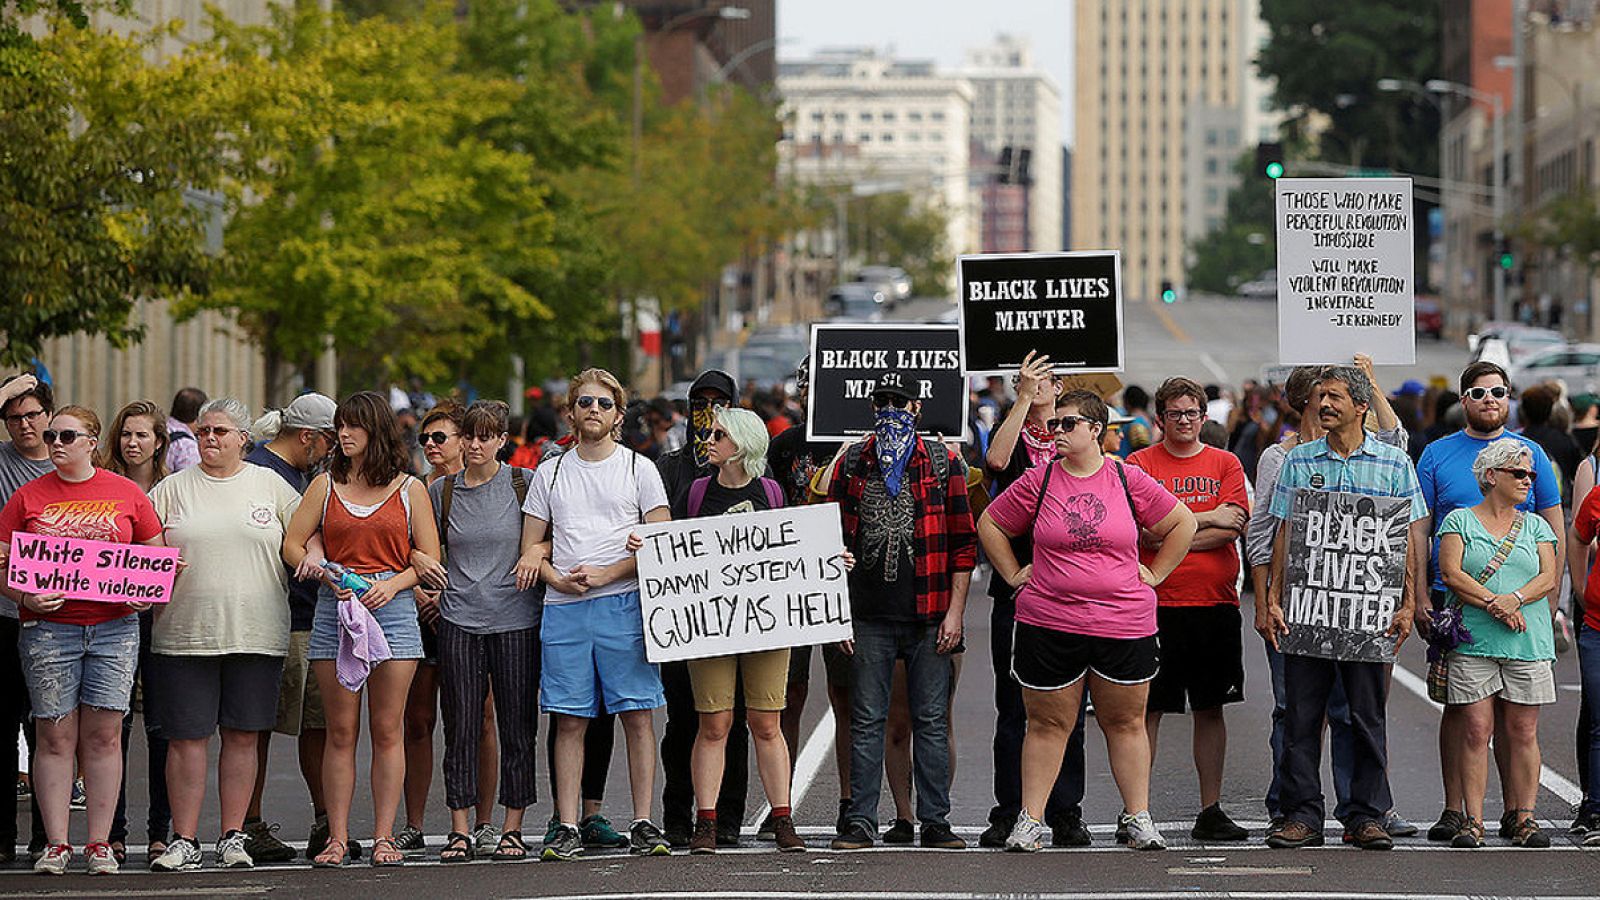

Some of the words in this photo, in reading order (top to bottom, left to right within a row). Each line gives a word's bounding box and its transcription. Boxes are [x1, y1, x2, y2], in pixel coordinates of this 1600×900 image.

[1282, 192, 1329, 209] THOSE
[1334, 192, 1364, 210] WHO
[1368, 193, 1403, 210] MAKE
[1286, 214, 1343, 230] PEACEFUL
[1346, 214, 1407, 231] REVOLUTION
[1313, 233, 1375, 248] IMPOSSIBLE
[1312, 260, 1340, 273] WILL
[1347, 260, 1378, 274] MAKE
[969, 279, 1037, 301] BLACK
[1045, 278, 1110, 299] LIVES
[1289, 275, 1338, 293] VIOLENT
[1341, 276, 1405, 293] REVOLUTION
[1305, 295, 1374, 310] INEVITABLE
[995, 309, 1086, 331] MATTER
[821, 350, 888, 369] BLACK
[897, 350, 959, 369] LIVES
[845, 379, 933, 399] MAR
[645, 529, 709, 565] THE
[715, 521, 800, 556] WHOLE
[1305, 510, 1393, 554] BLACK
[17, 538, 84, 564] White
[96, 549, 174, 572] Silence
[10, 565, 28, 584] is
[34, 568, 90, 591] white
[98, 577, 165, 598] violence
[646, 569, 708, 599] DAMN
[721, 557, 807, 587] SYSTEM
[818, 554, 842, 581] IS
[1307, 549, 1383, 592] LIVES
[1289, 587, 1395, 631] MATTER
[649, 594, 739, 649] GUILTY
[745, 595, 776, 634] AS
[787, 592, 850, 629] HELL
